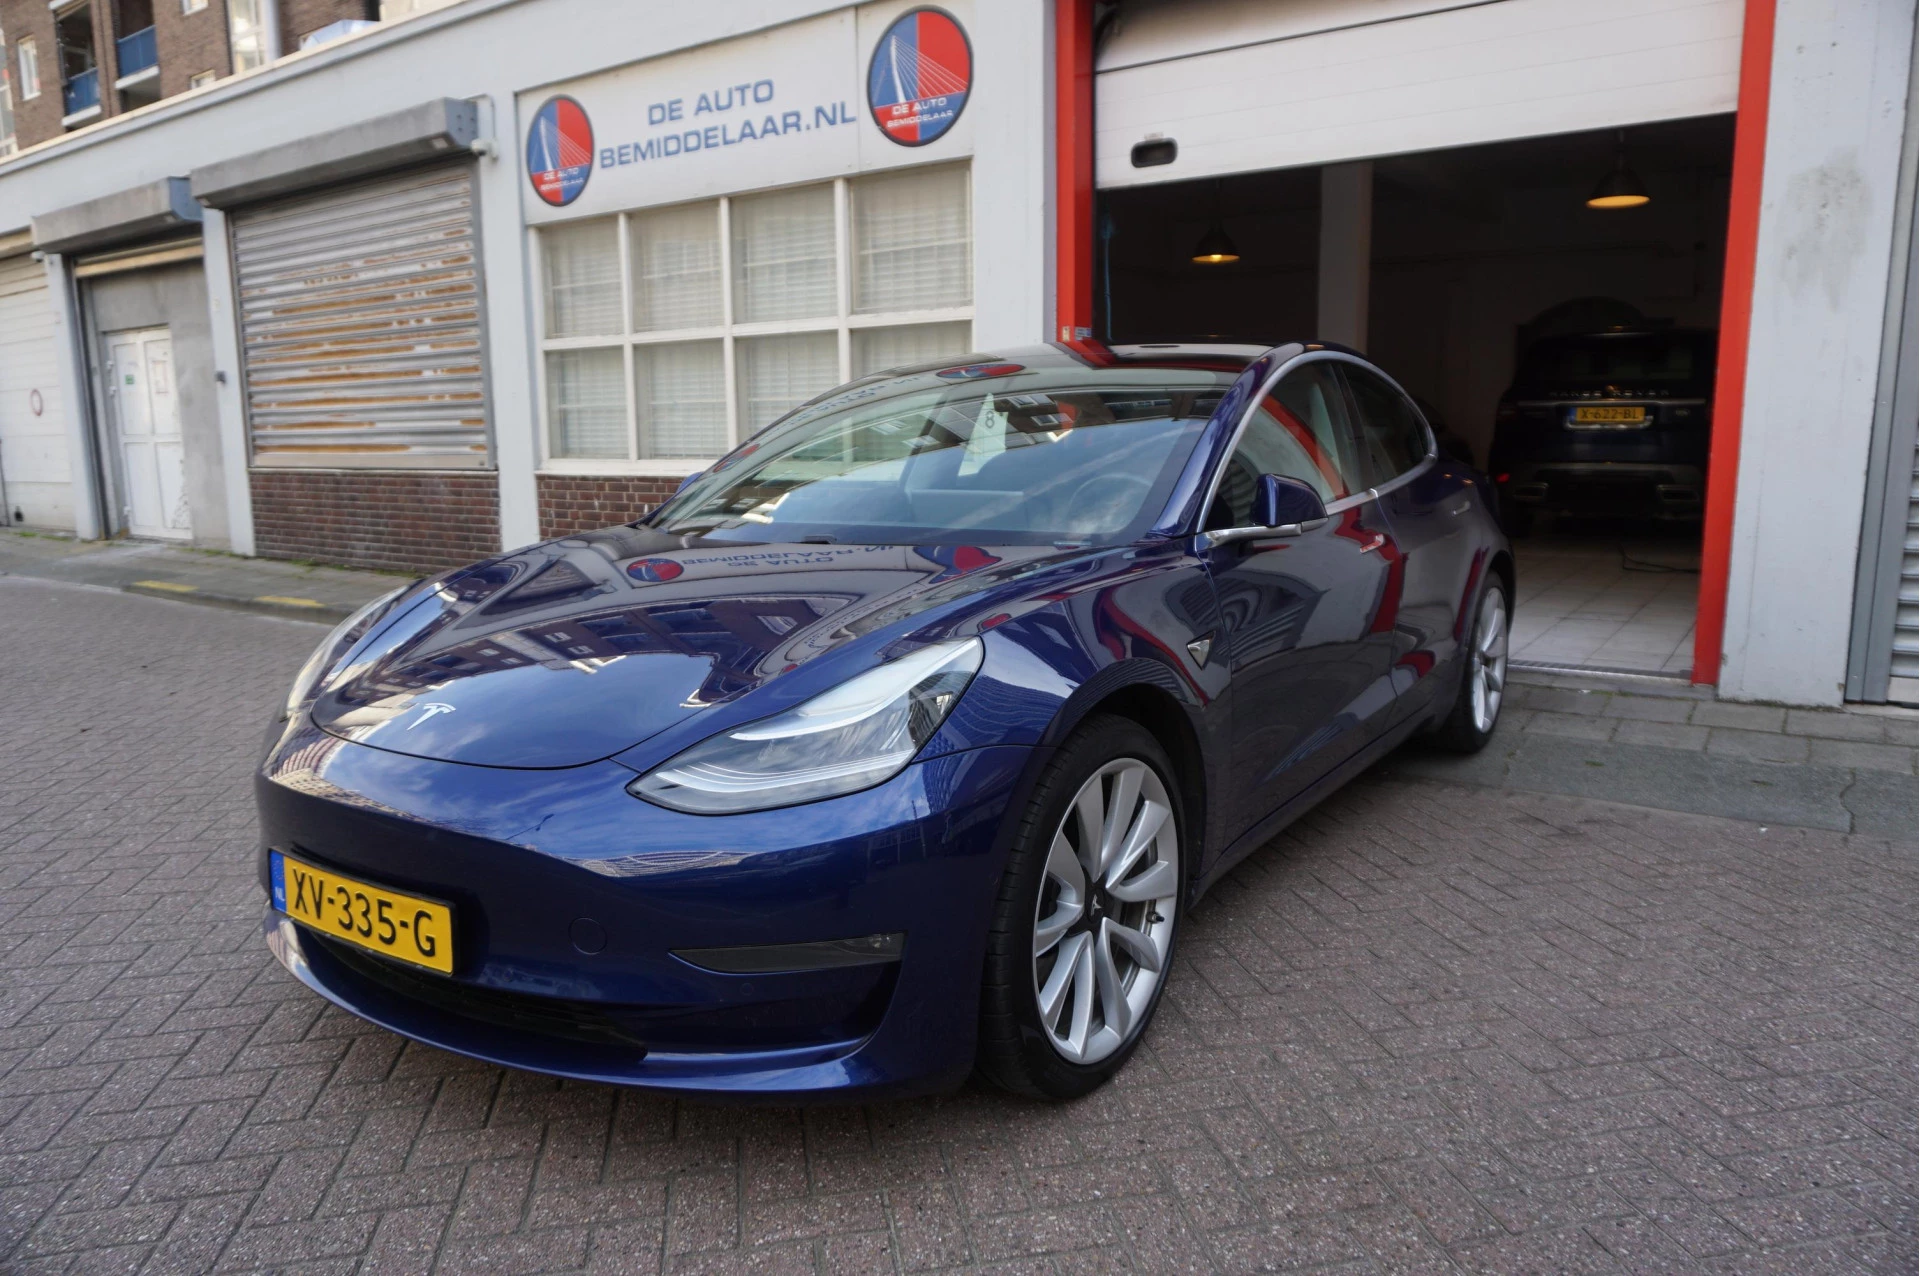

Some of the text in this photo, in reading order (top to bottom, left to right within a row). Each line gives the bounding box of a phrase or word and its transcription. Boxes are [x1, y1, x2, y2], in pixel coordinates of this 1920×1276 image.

[648, 79, 774, 126] DE AUTO
[887, 109, 954, 128] BEMIDDELAAR
[892, 97, 948, 115] DE AUTO
[599, 101, 857, 169] BEMIDDELAAR.NL
[275, 886, 285, 901] NL
[292, 868, 436, 957] XV-335-G
